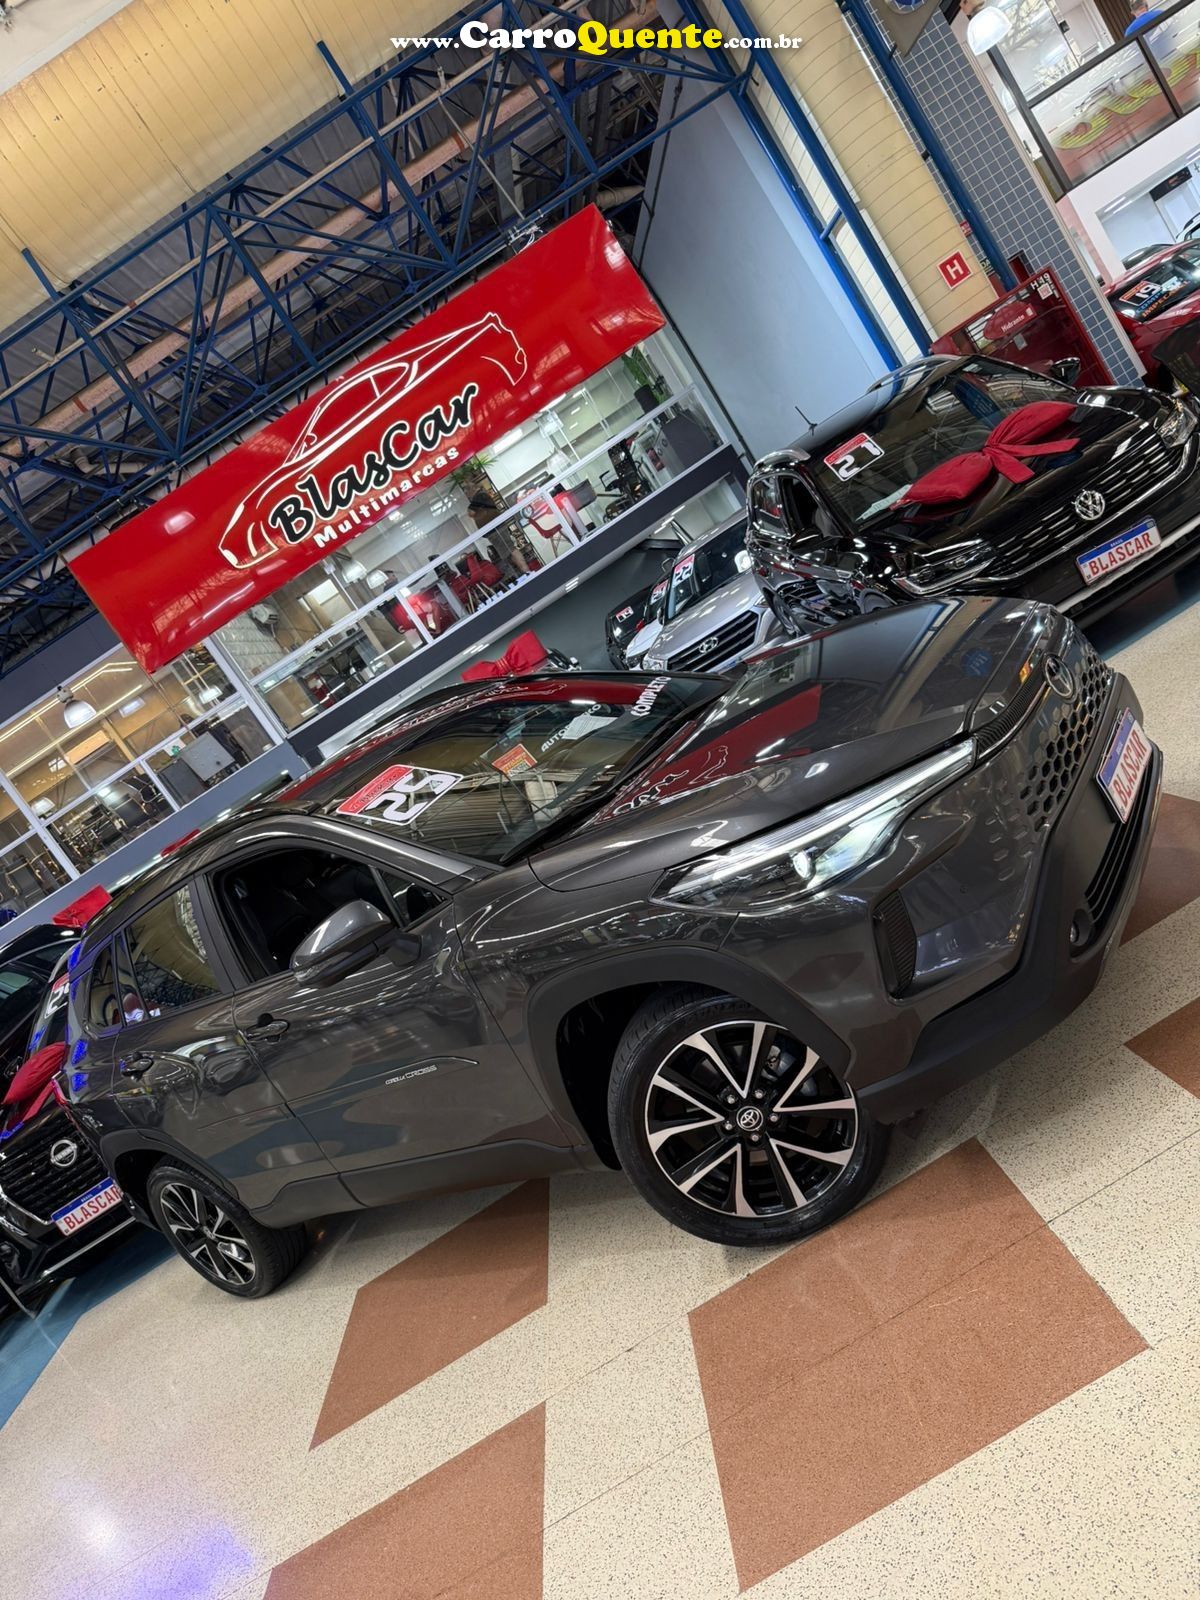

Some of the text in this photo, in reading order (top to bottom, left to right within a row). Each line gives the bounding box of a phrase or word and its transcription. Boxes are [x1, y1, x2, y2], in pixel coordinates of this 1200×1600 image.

[946, 259, 964, 280] H
[1135, 284, 1161, 299] 19
[269, 383, 479, 544] BlasCar
[834, 442, 881, 478] 21
[313, 447, 460, 548] Multimarcas
[1088, 532, 1153, 576] BLASCAR
[630, 676, 672, 717] COMPLETO
[541, 704, 601, 752] AUTOCO
[1113, 729, 1147, 808] BLASCAR
[365, 772, 458, 821] 25
[405, 1064, 438, 1079] CROSS
